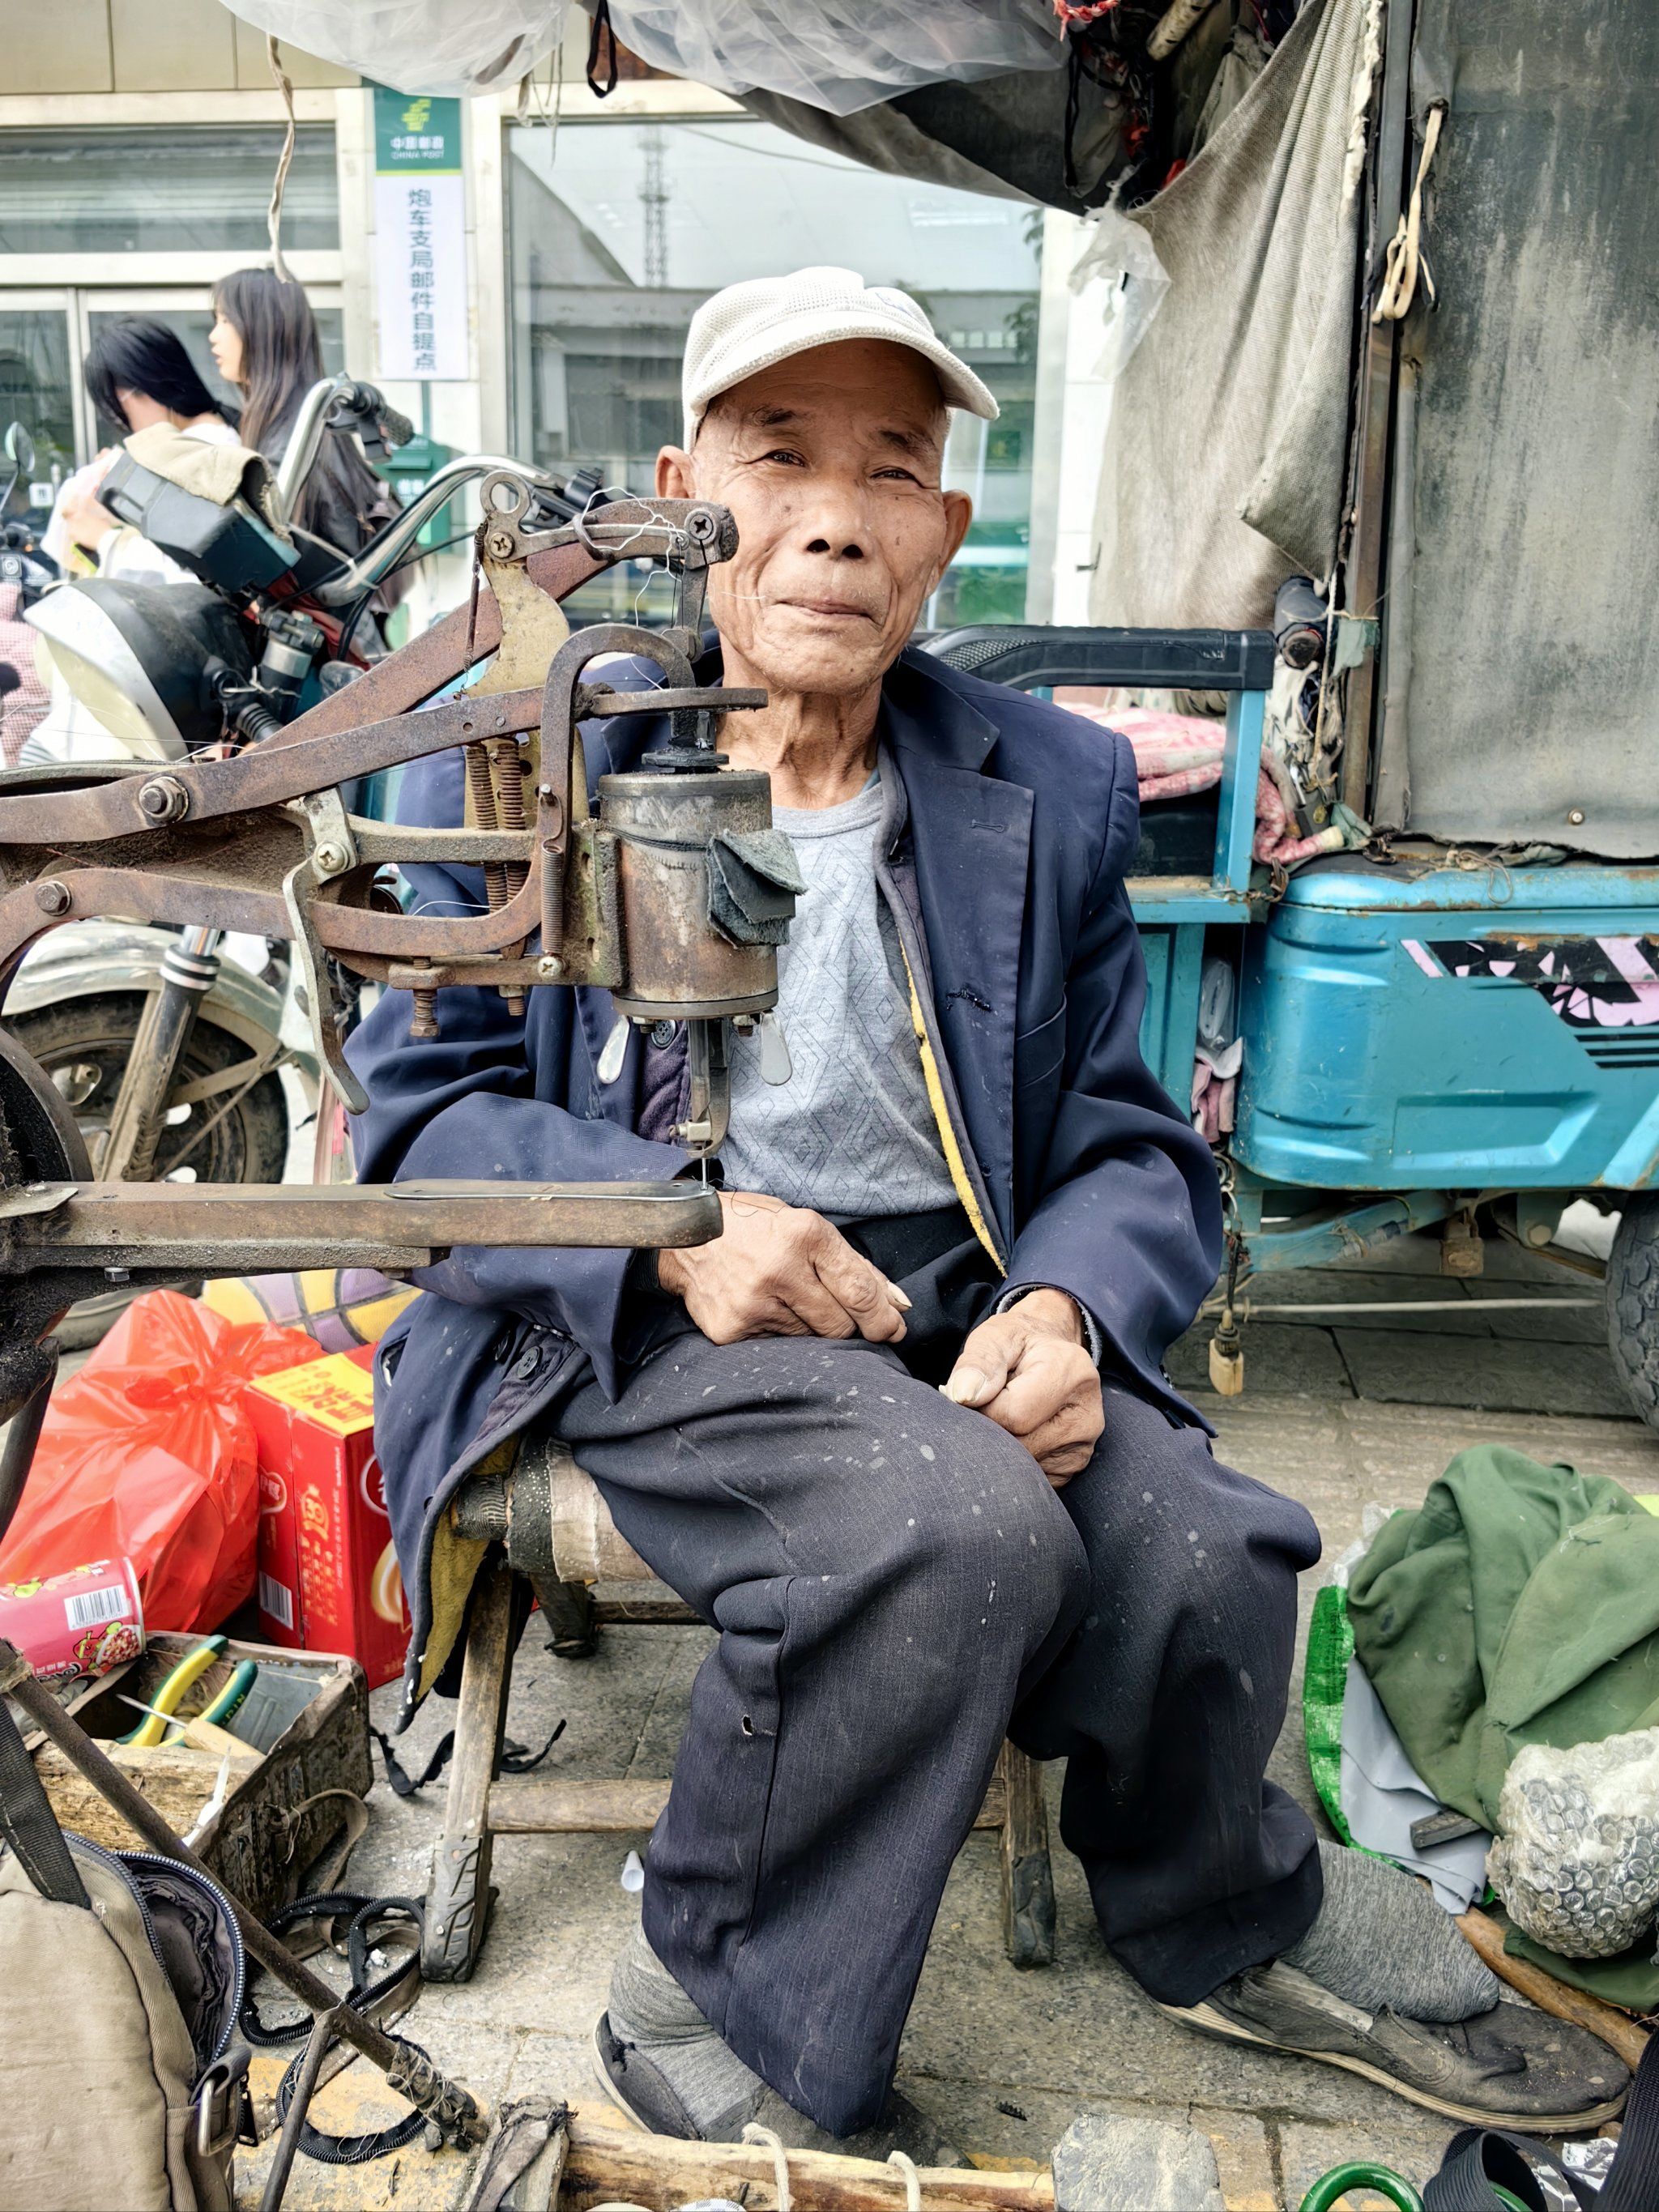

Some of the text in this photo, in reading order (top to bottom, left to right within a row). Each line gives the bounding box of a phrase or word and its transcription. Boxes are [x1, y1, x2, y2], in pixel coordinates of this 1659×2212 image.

[408, 188, 437, 371] 炮车支局邮件自提点
